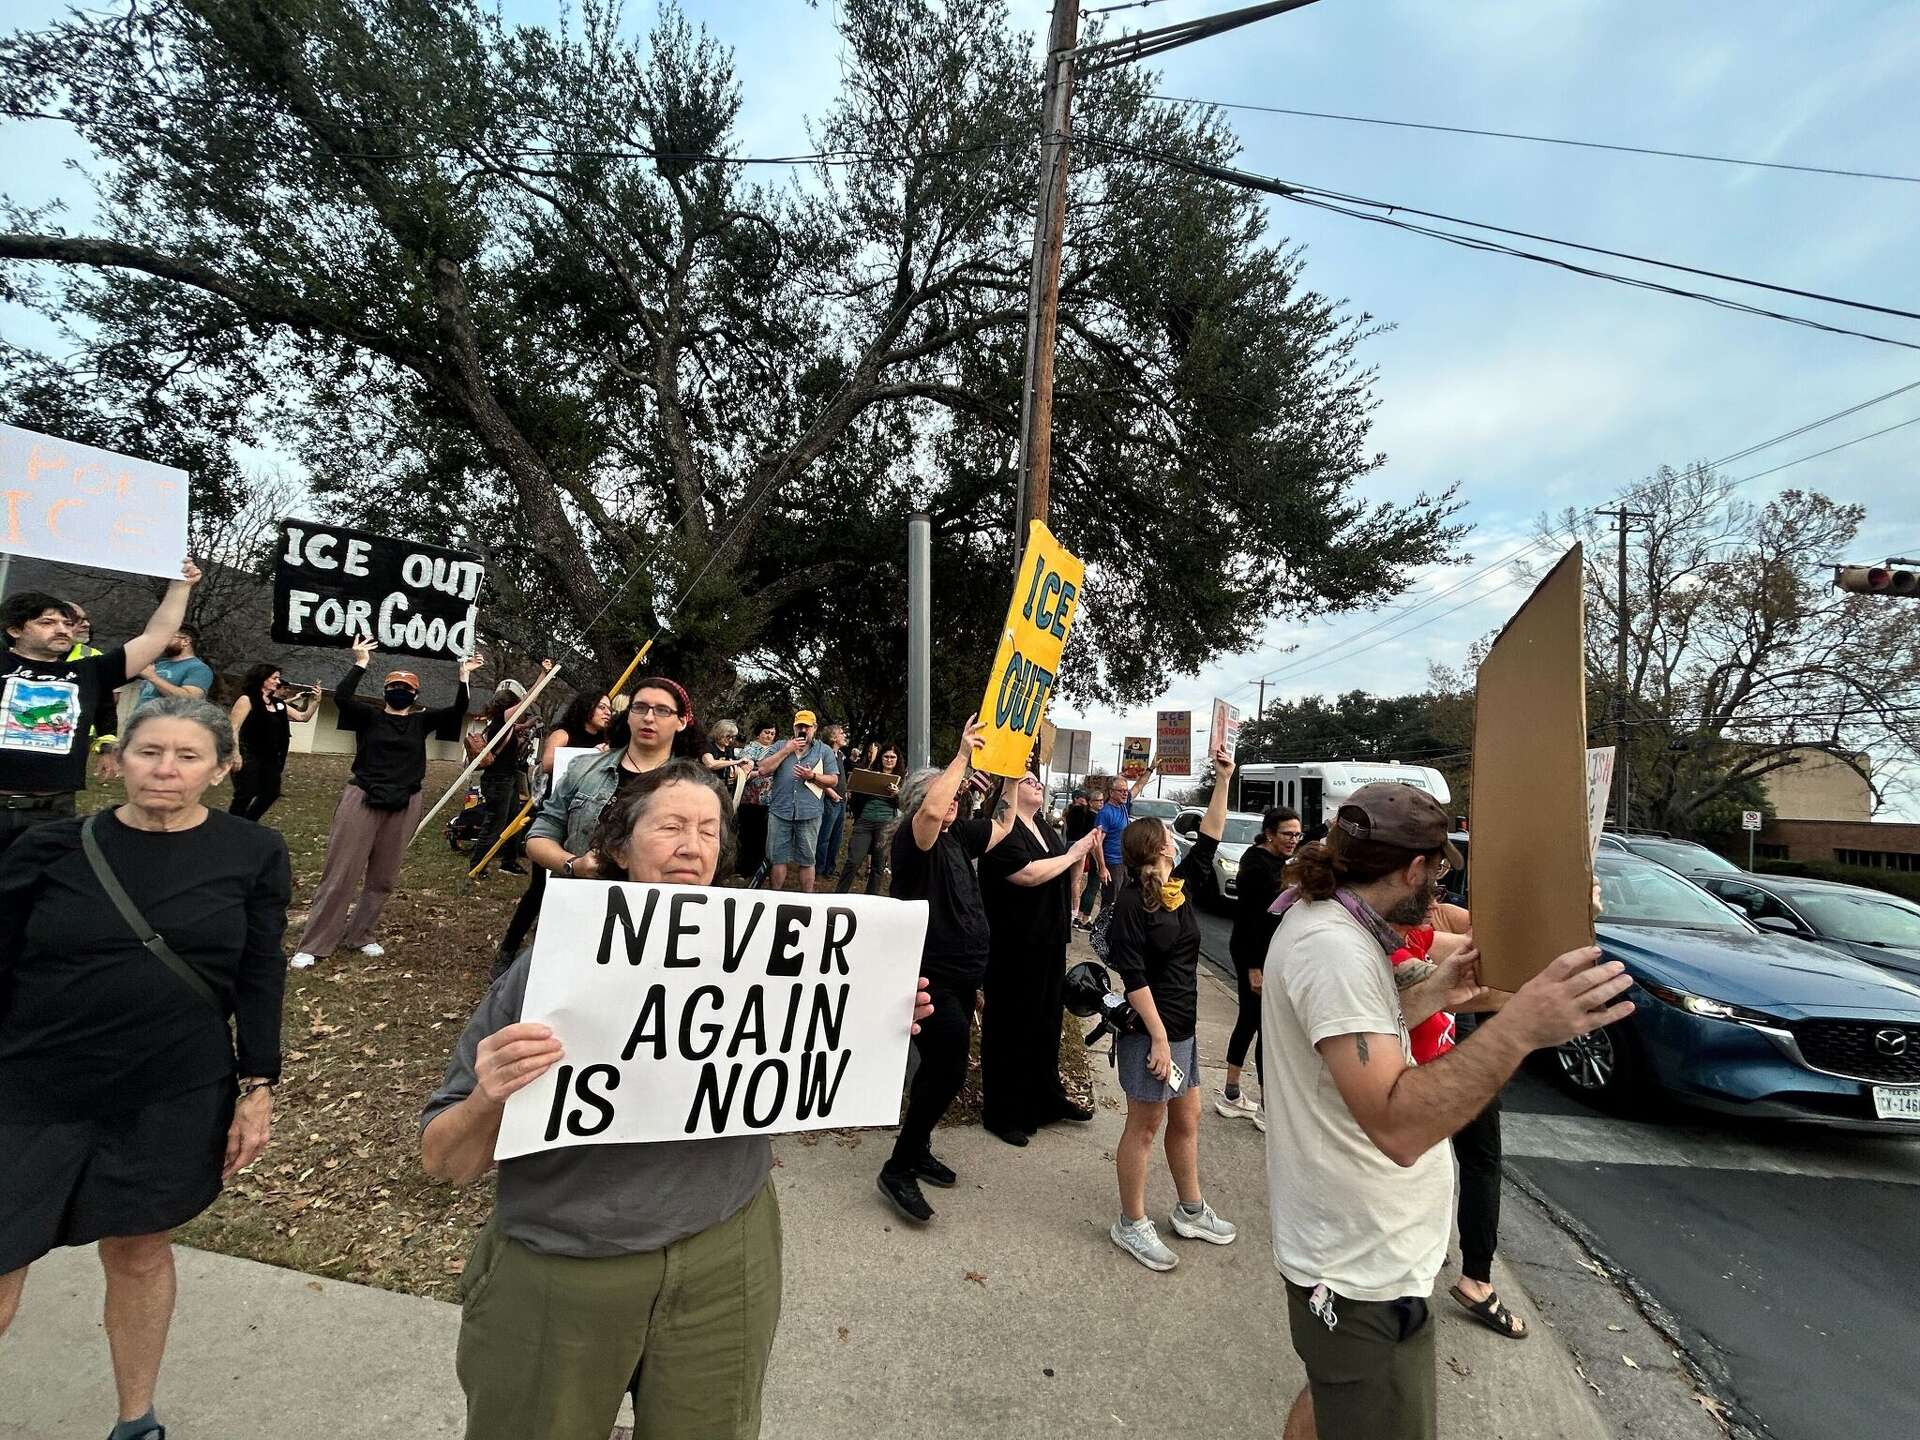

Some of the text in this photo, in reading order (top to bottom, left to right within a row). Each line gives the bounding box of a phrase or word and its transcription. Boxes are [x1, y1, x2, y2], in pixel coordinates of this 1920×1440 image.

[283, 527, 484, 600] ICE OUT
[1022, 553, 1076, 642] ICE
[287, 589, 373, 637] FOR
[995, 651, 1054, 737] OUT
[1159, 712, 1185, 721] ICE
[597, 885, 858, 977] NEVER
[621, 983, 850, 1061] AGAIN
[544, 1049, 851, 1142] IS NOW
